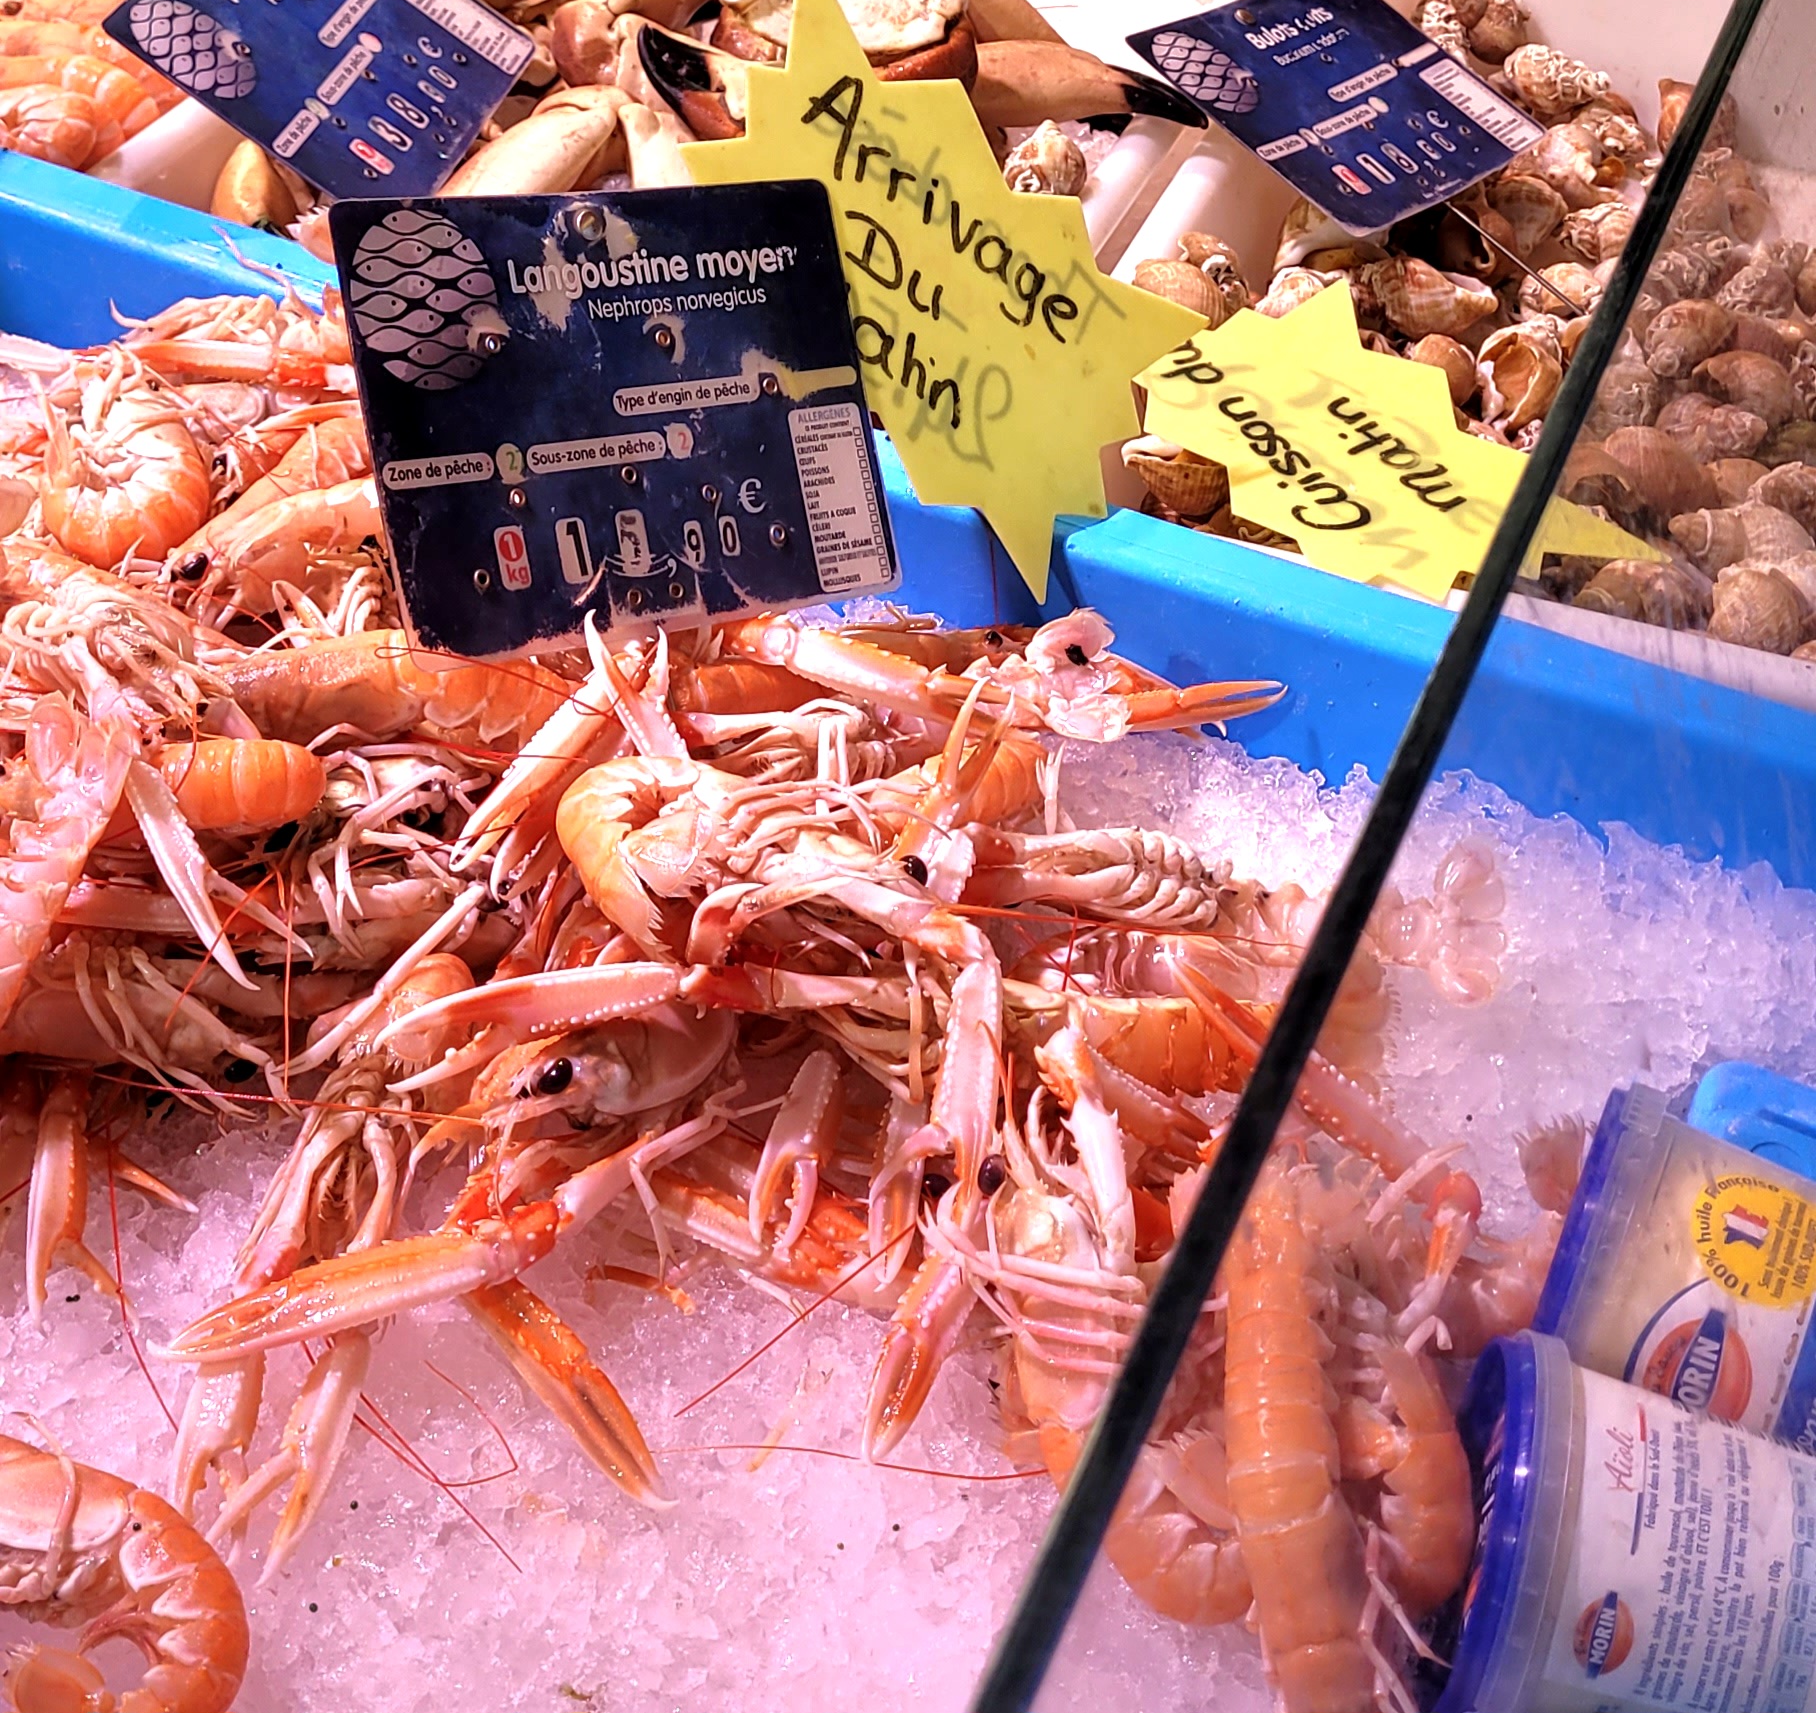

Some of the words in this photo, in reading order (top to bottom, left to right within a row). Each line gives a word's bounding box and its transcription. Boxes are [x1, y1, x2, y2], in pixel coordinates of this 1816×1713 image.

[1244, 21, 1297, 51] Bulots
[800, 74, 1080, 345] Arrivage
[507, 248, 689, 300] Langoustine
[588, 294, 672, 323] Nephrops
[676, 286, 767, 312] norvegicus
[852, 312, 961, 430] atin
[615, 393, 645, 412] Type
[647, 389, 693, 408] d'engin
[696, 384, 711, 400] de
[714, 381, 750, 401] pêche
[797, 407, 851, 423] ALLERGÈNES
[531, 447, 596, 466] Sous-zone
[599, 442, 615, 458] de
[618, 439, 655, 461] pêche
[797, 443, 828, 455] CRUSTACÉS
[388, 467, 422, 483] Zone
[425, 462, 443, 478] de
[445, 458, 483, 481] pêche
[801, 465, 830, 477] POISSONS
[1218, 395, 1373, 530] Cuisson
[803, 476, 835, 488] ARACHIDES
[805, 490, 820, 499] SOJA
[807, 501, 820, 510] LAIT
[810, 511, 830, 521] FRUITS
[836, 507, 856, 517] COQUE
[566, 515, 740, 578] 1,90
[738, 478, 766, 514] €
[814, 531, 846, 543] MOUTARDE
[816, 543, 841, 554] GRAINES
[842, 542, 850, 550] DE
[850, 537, 873, 548] SÉSAME
[506, 564, 529, 585] kg
[821, 567, 839, 576] LUPIN
[823, 574, 861, 587] MOLLUSQUES
[1695, 1201, 1712, 1244] huile
[1701, 1247, 1751, 1298] 100%
[1676, 1334, 1721, 1409] ORIN
[1647, 1471, 1660, 1490] dans
[1697, 1492, 1714, 1516] TOUT
[1696, 1517, 1712, 1542] C'EST
[1695, 1542, 1709, 1554] ET
[1733, 1537, 1748, 1557] bien
[1663, 1554, 1676, 1567] de
[1732, 1561, 1746, 1578] pot
[1767, 1559, 1784, 1583] 100g
[1657, 1570, 1673, 1594] huile
[1767, 1586, 1780, 1608] pour
[1649, 1604, 1668, 1639] simples
[1736, 1618, 1750, 1632] 10
[1588, 1606, 1617, 1665] MORIN
[1732, 1633, 1747, 1647] les
